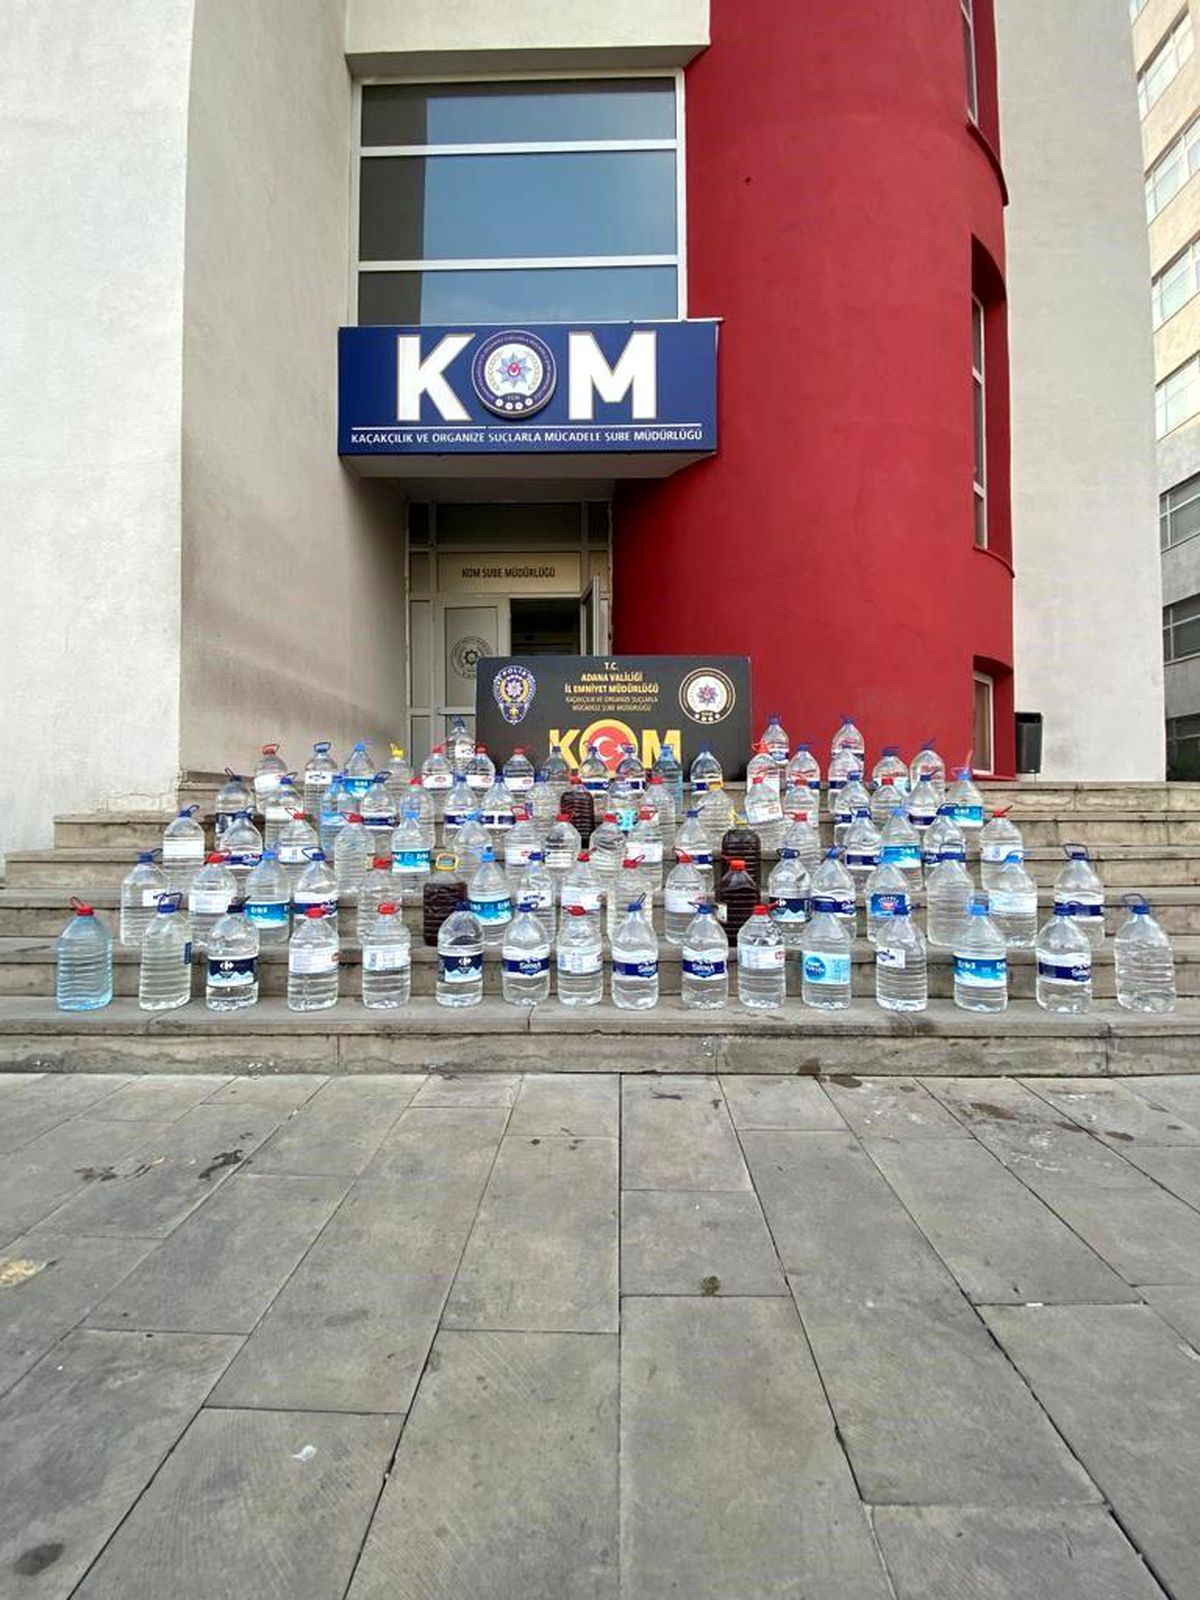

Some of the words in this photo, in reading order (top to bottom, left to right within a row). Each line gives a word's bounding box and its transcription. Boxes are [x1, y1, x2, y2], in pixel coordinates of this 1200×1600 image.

[351, 433, 413, 445] KAÇAKÇILIK
[416, 432, 429, 443] VE
[461, 567, 480, 578] KOM
[603, 662, 619, 671] T.C.
[580, 673, 608, 682] ADANA
[609, 671, 643, 682] VALİLİĞİ
[564, 682, 572, 693] İL
[573, 683, 608, 693] EMNİYET
[609, 682, 659, 693] MÜDÜRLÜĞÜ
